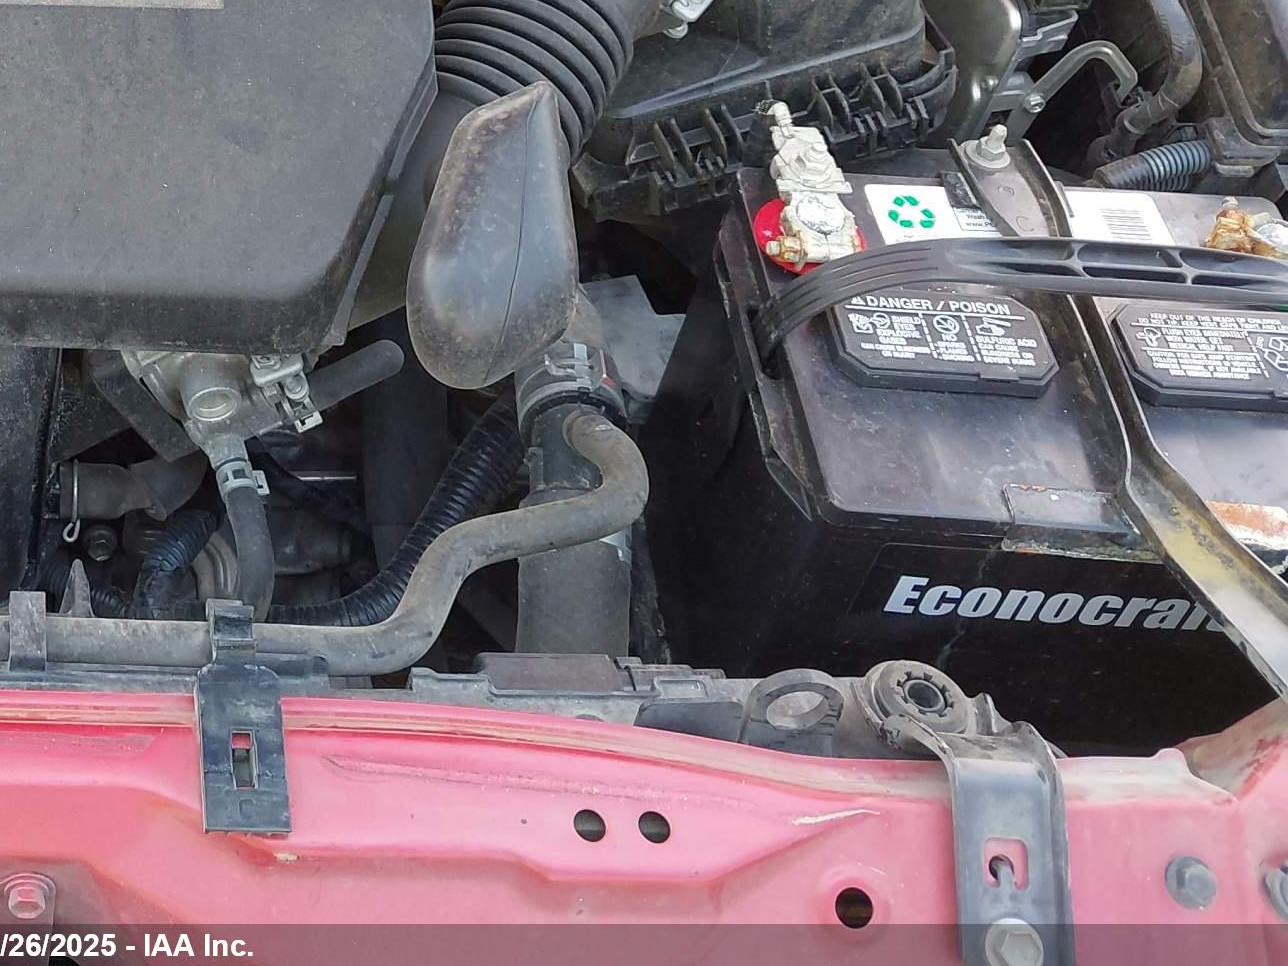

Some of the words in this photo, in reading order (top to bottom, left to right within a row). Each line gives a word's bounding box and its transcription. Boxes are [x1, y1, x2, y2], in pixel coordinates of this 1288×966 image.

[865, 295, 933, 311] DANGER
[936, 300, 946, 311] /
[949, 300, 1011, 315] POISON
[891, 315, 921, 324] SHIELD
[941, 334, 958, 342] NO
[975, 335, 1016, 345] SULFURIC
[1017, 338, 1038, 348] ACID
[883, 575, 1225, 632] Econocraf
